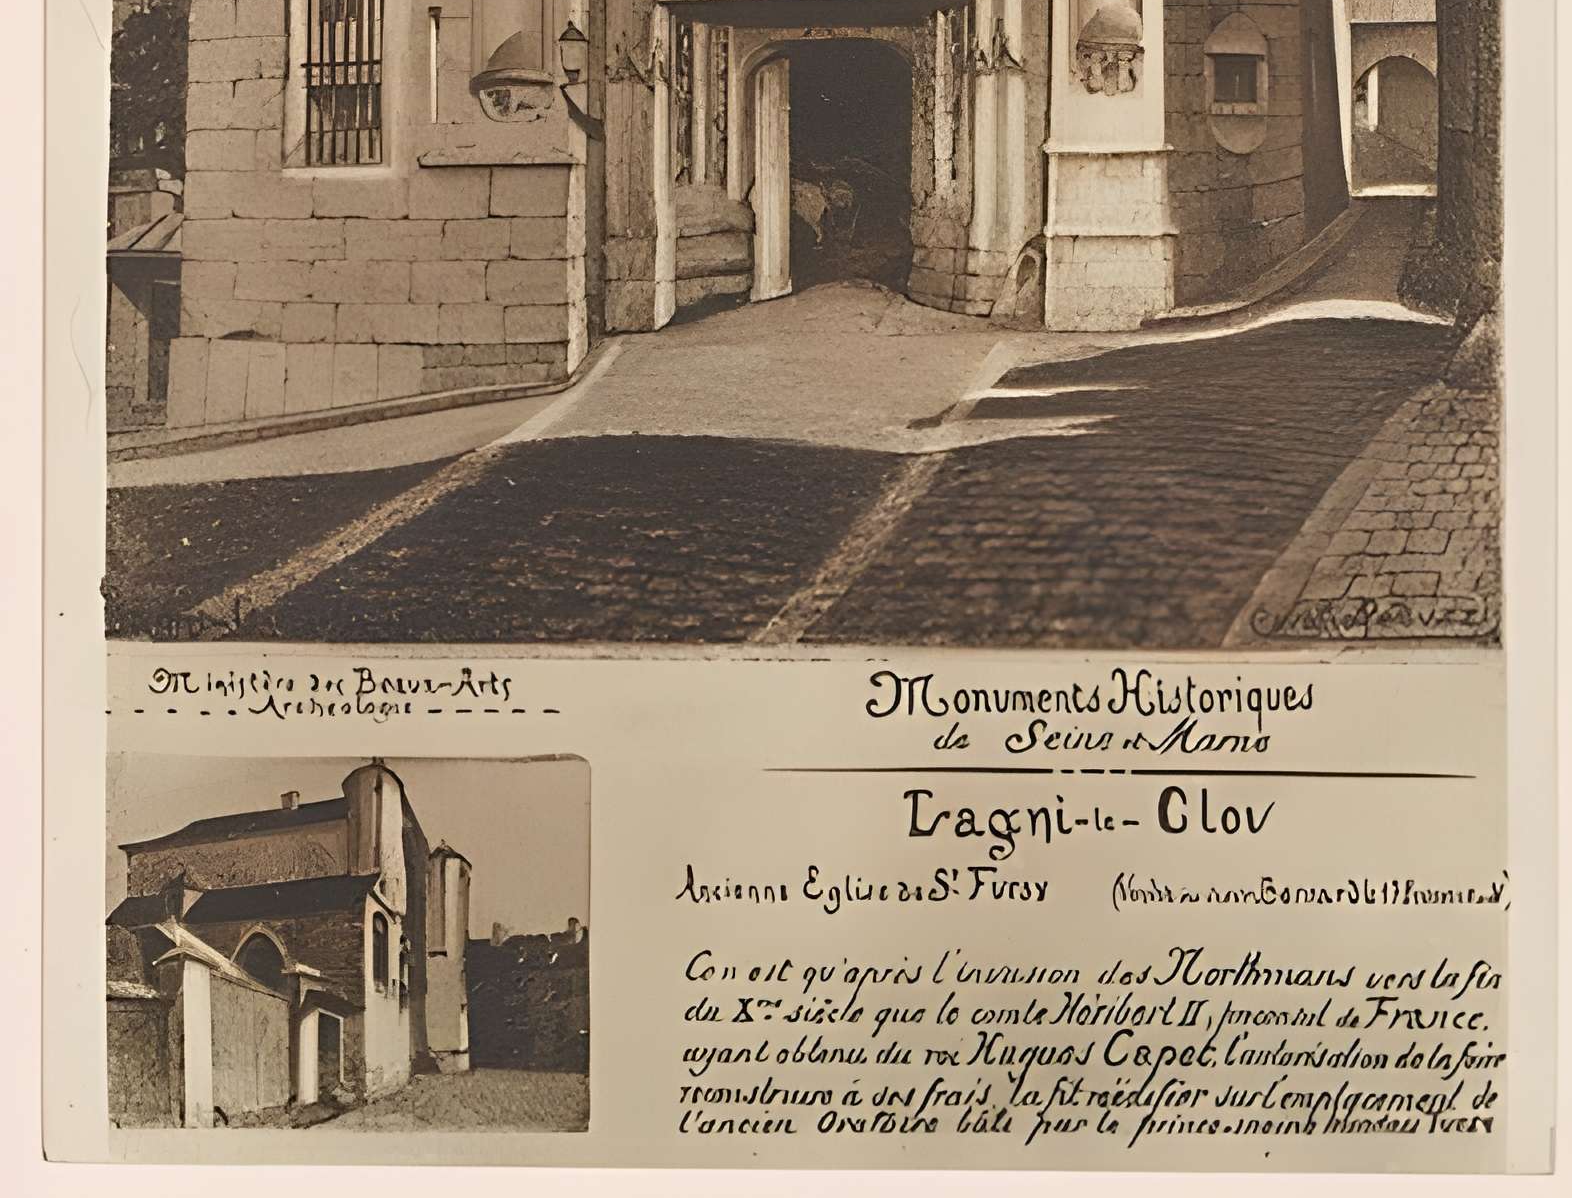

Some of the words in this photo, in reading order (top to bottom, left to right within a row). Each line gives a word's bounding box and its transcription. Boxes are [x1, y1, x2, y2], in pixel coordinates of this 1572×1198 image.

[866, 670, 1100, 718] Monuments
[1107, 668, 1314, 732] Historiques
[933, 722, 971, 751] de
[1365, 968, 1426, 990] vers
[1472, 1080, 1499, 1110] de
